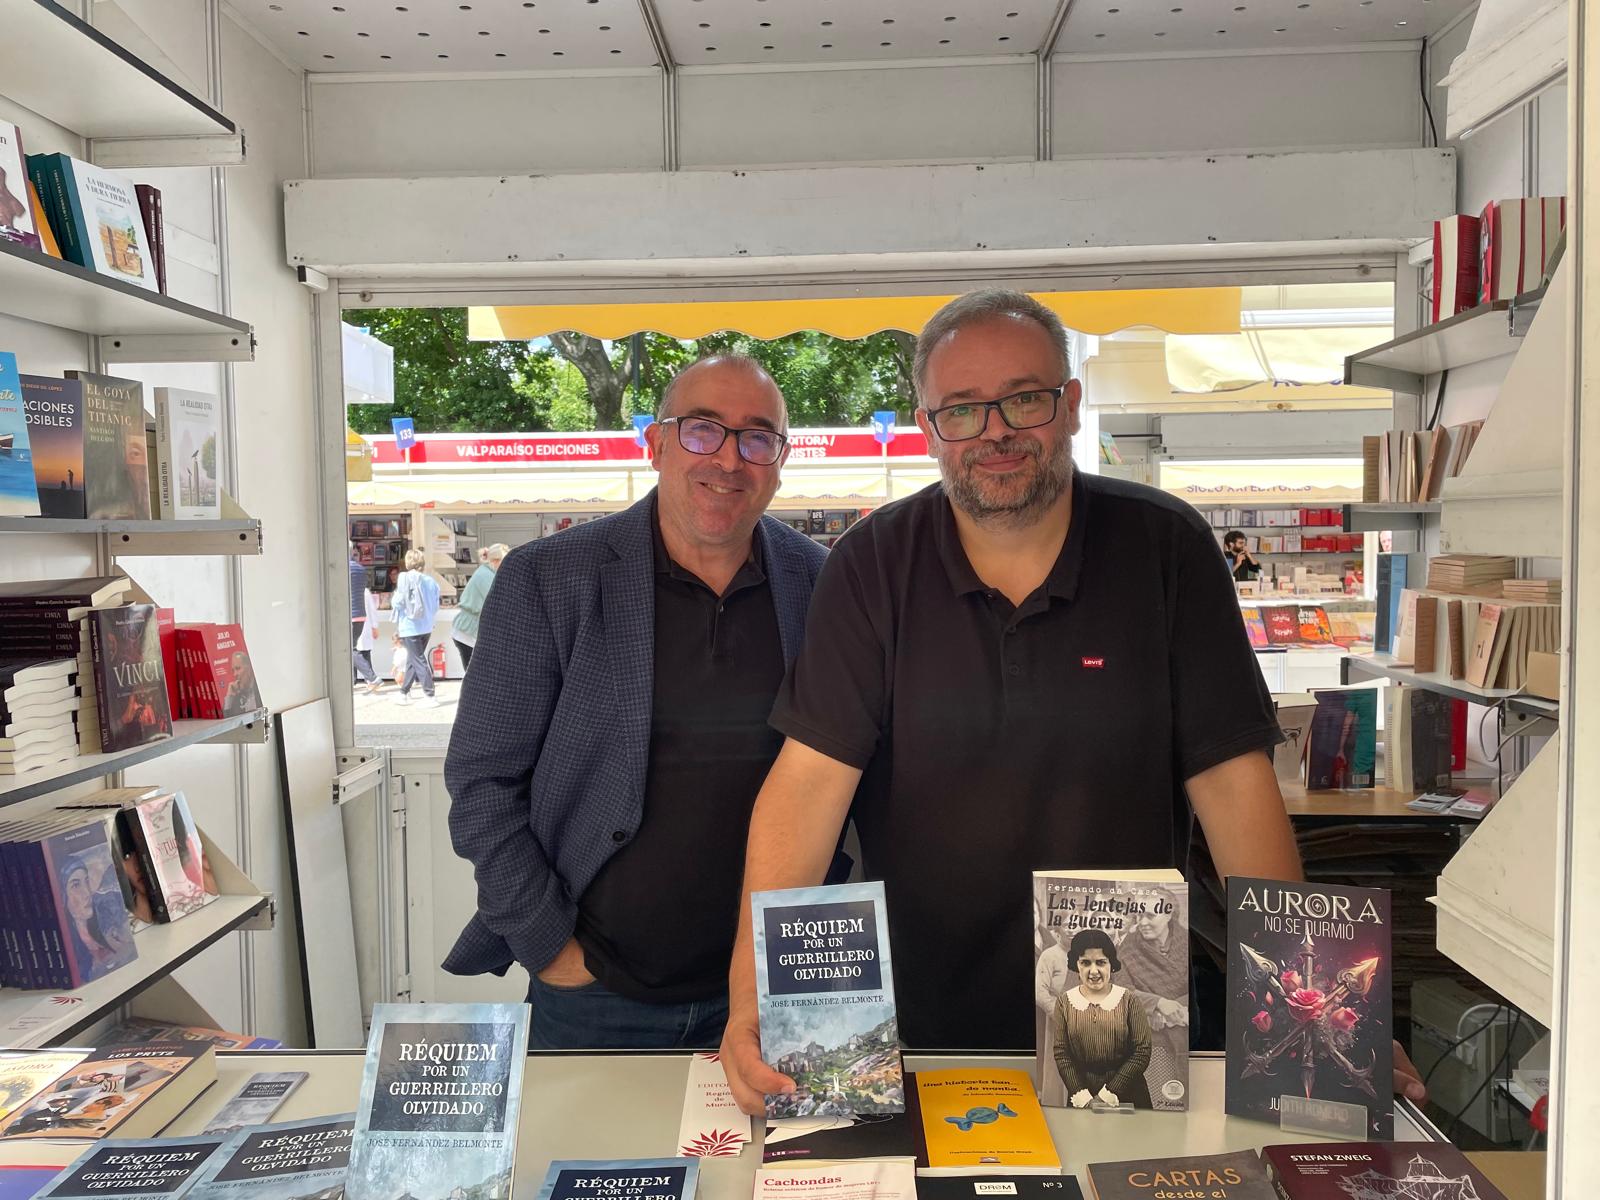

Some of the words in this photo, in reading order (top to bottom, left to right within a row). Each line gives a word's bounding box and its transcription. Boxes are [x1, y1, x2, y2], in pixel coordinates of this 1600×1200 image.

[87, 383, 100, 395] EL
[104, 386, 131, 400] GOYA
[88, 397, 108, 410] DEL
[25, 413, 73, 427] OSIBLES
[88, 411, 132, 426] TITANIC
[400, 428, 412, 440] 133
[456, 443, 534, 457] VALPARAÍSO
[536, 443, 600, 456] EDICIONES
[113, 660, 160, 687] VINCI
[1047, 883, 1102, 894] Fernando
[1047, 893, 1076, 911] Las
[1083, 894, 1147, 916] lentejas
[1153, 898, 1173, 915] de
[1237, 887, 1384, 925] AURORA
[1047, 911, 1062, 928] la
[1068, 914, 1124, 930] guerra
[780, 918, 864, 938] RÉQUIEM
[1264, 915, 1281, 933] NO
[1285, 917, 1301, 935] SE
[1305, 919, 1355, 941] DURMIÓ
[803, 939, 825, 949] POR
[828, 937, 843, 947] UN
[779, 950, 875, 966] GUERRILLERO
[794, 966, 862, 981] OLVIDADO
[770, 999, 789, 1008] JOSÉ
[791, 997, 840, 1007] FERNÁNDEZ
[842, 995, 884, 1005] BELMONTE
[399, 1038, 498, 1064] RÉQUIEM
[422, 1065, 447, 1077] POR
[452, 1065, 470, 1077] UN
[389, 1082, 503, 1096] GUERRILLERO
[403, 1101, 484, 1115] OLVIDADO
[258, 1129, 354, 1149] RÉQUIEM
[278, 1143, 304, 1152] POR
[307, 1140, 326, 1148] UN
[367, 1137, 389, 1147] JOSÉ
[452, 1139, 503, 1149] BELMONTE
[102, 1151, 201, 1165] RÉQUIEM
[241, 1144, 352, 1164] GUERRILLERO
[119, 1163, 144, 1171] POR
[147, 1162, 166, 1170] UN
[251, 1155, 333, 1172] OLVIDADO
[81, 1169, 190, 1181] GUERRILLERO
[573, 1176, 672, 1188] RÉQUIEM
[764, 1175, 842, 1186] Cachondas
[1128, 1168, 1243, 1188] CARTAS
[86, 1178, 165, 1189] OLVIDADO
[626, 1187, 644, 1195] UN
[1154, 1189, 1206, 1199] desde
[1213, 1188, 1227, 1199] el
